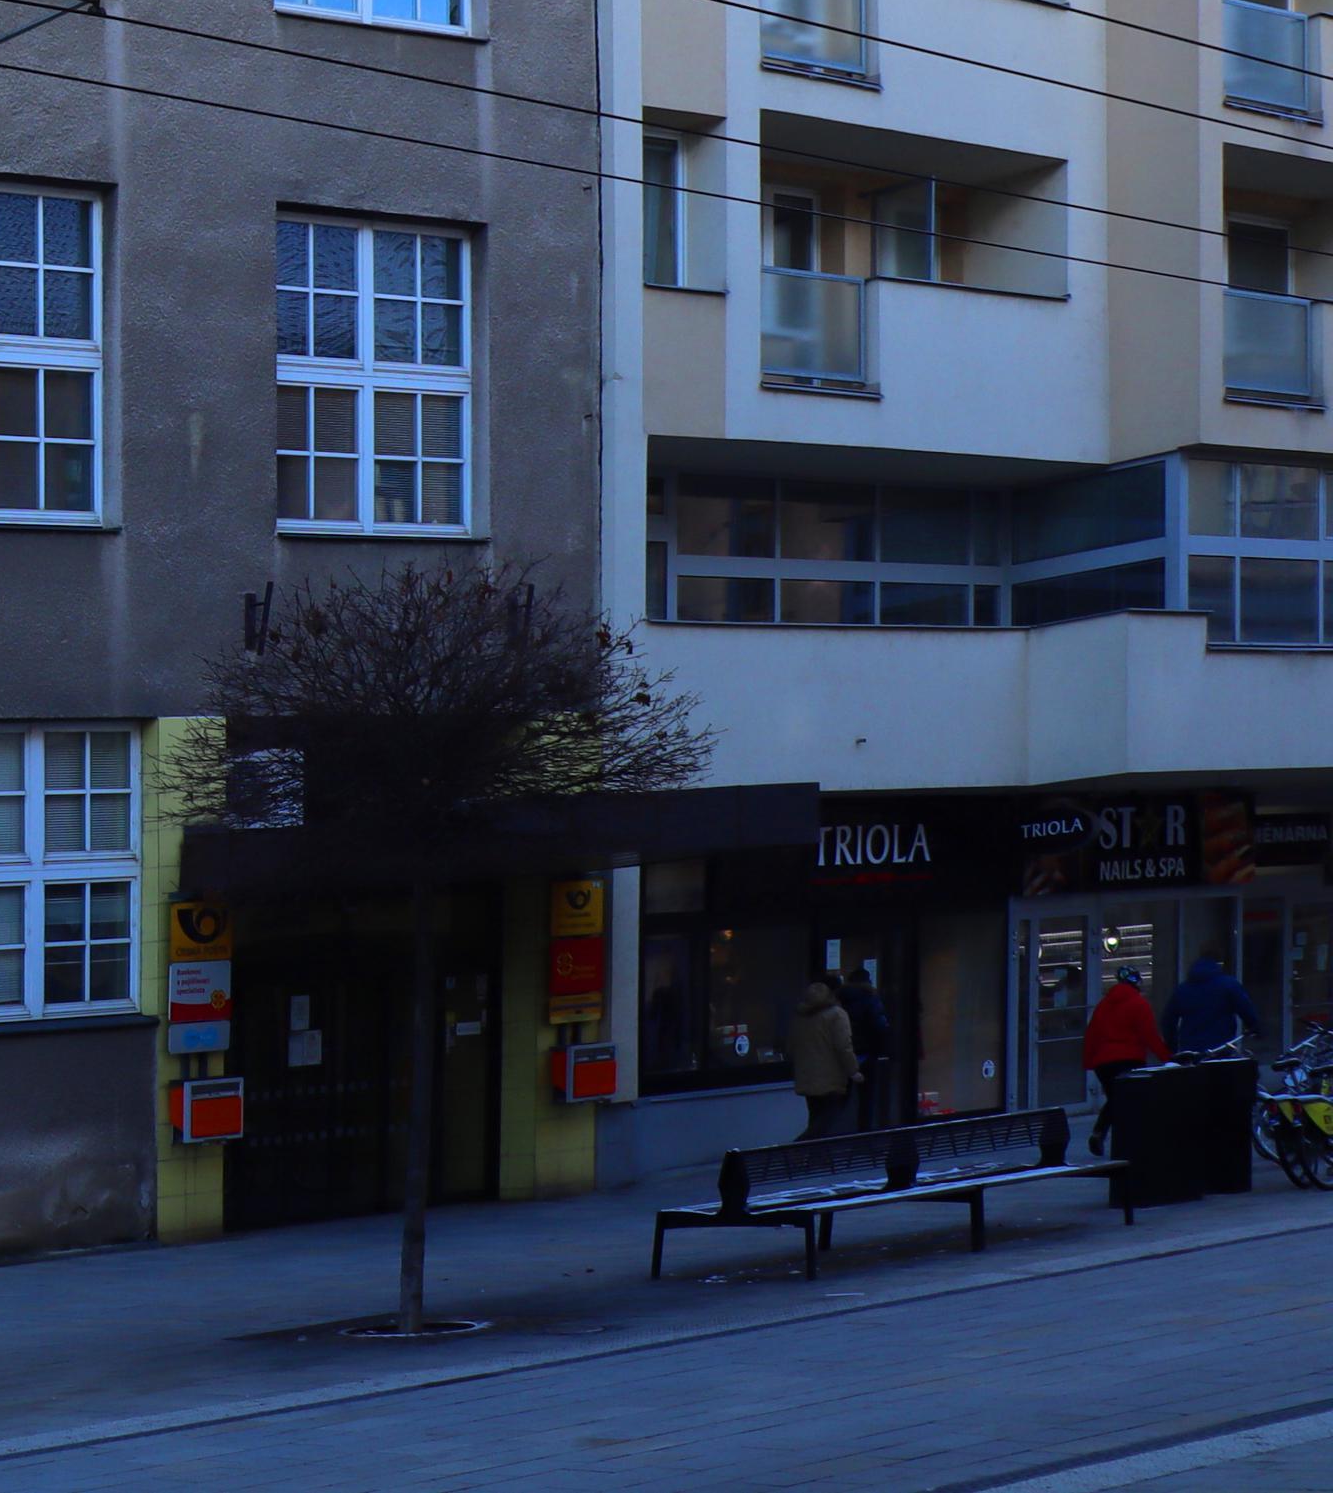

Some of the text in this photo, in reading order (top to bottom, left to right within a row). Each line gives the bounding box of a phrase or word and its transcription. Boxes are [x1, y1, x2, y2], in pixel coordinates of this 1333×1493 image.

[1020, 816, 1084, 839] TRIOLA
[816, 822, 932, 867] TRIOLA
[1099, 856, 1186, 881] NAILS & SPA
